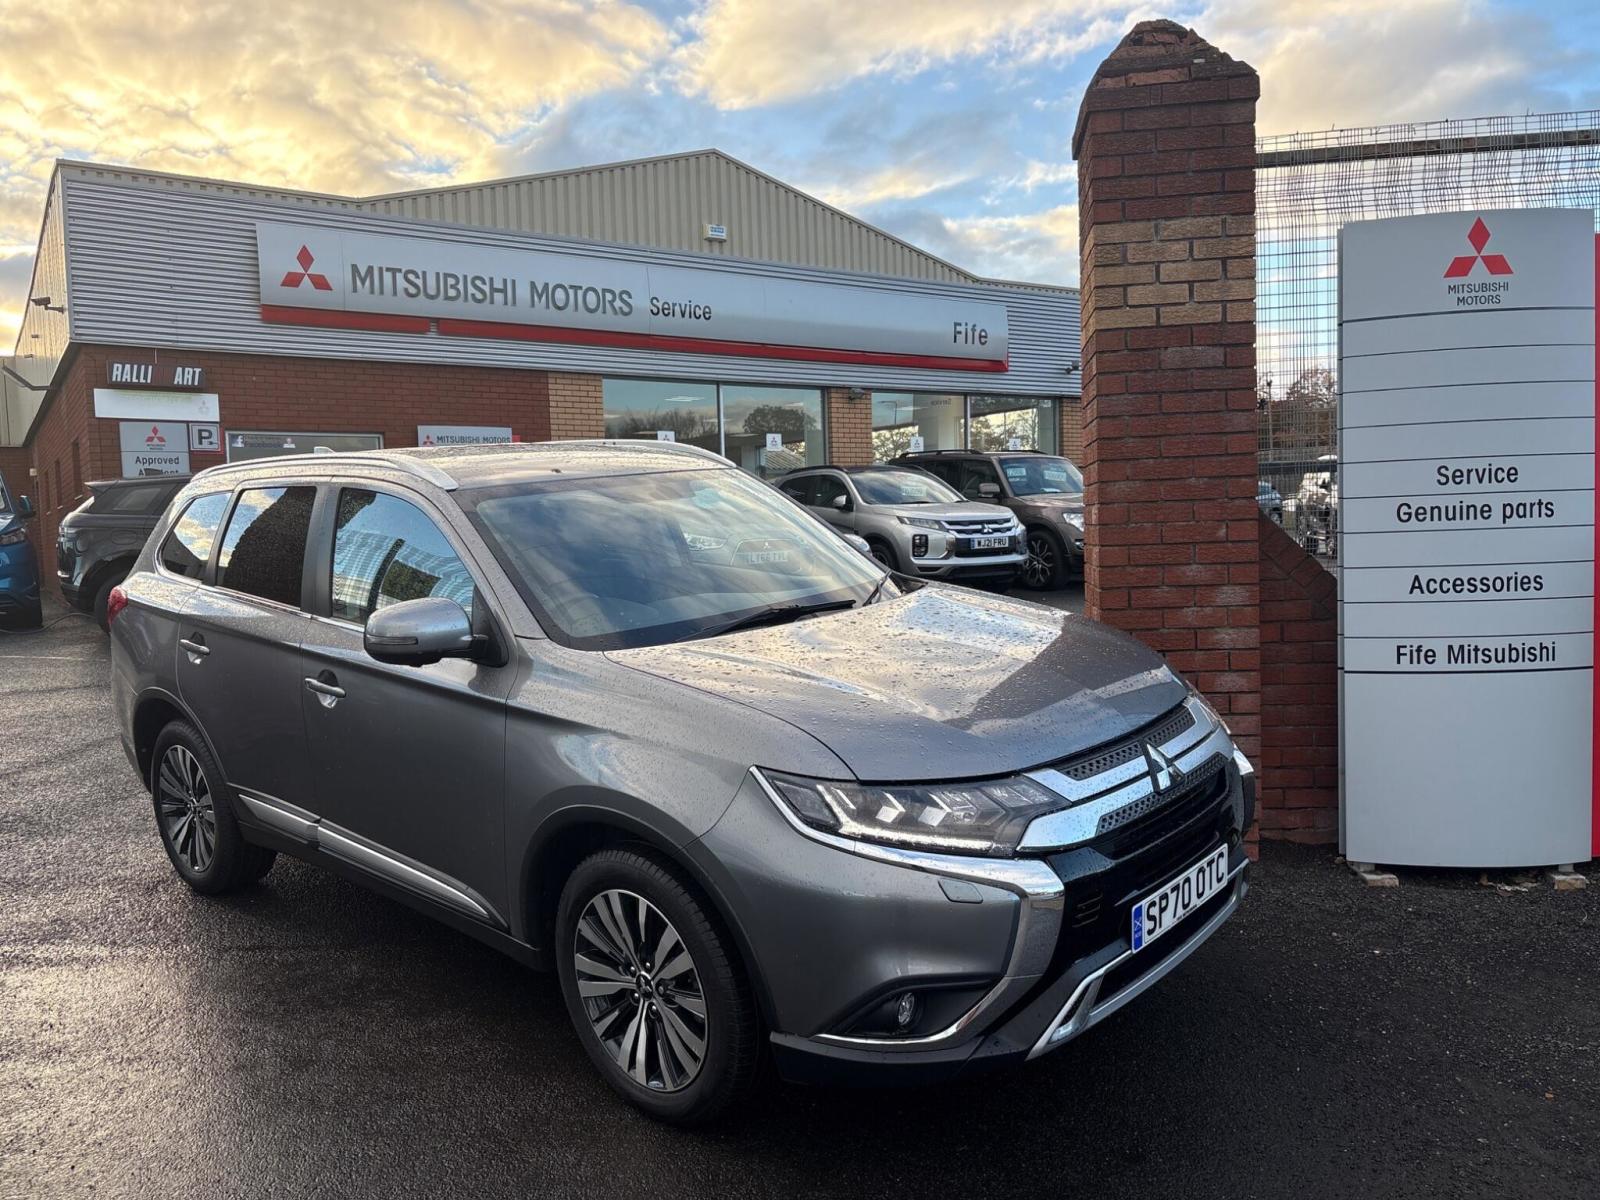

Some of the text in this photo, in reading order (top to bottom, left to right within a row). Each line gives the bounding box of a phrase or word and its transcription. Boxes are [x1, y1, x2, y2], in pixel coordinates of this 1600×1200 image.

[351, 263, 712, 321] MITSUBISHI MOTORS Service
[1448, 281, 1509, 295] MITSUBISHI
[1456, 294, 1501, 306] MOTORS
[953, 321, 988, 346] Fife
[173, 366, 202, 386] ART
[197, 428, 213, 446] P
[436, 434, 511, 444] MITSUBISHI MOTORS
[135, 456, 180, 466] Approved
[1436, 464, 1519, 486] Service
[1396, 497, 1555, 523] Genuine parts
[993, 536, 1007, 546] FRU
[1409, 572, 1544, 595] Accessories
[1396, 641, 1557, 665] Fife Mitsubishi
[1146, 851, 1225, 936] SP70 OTC
